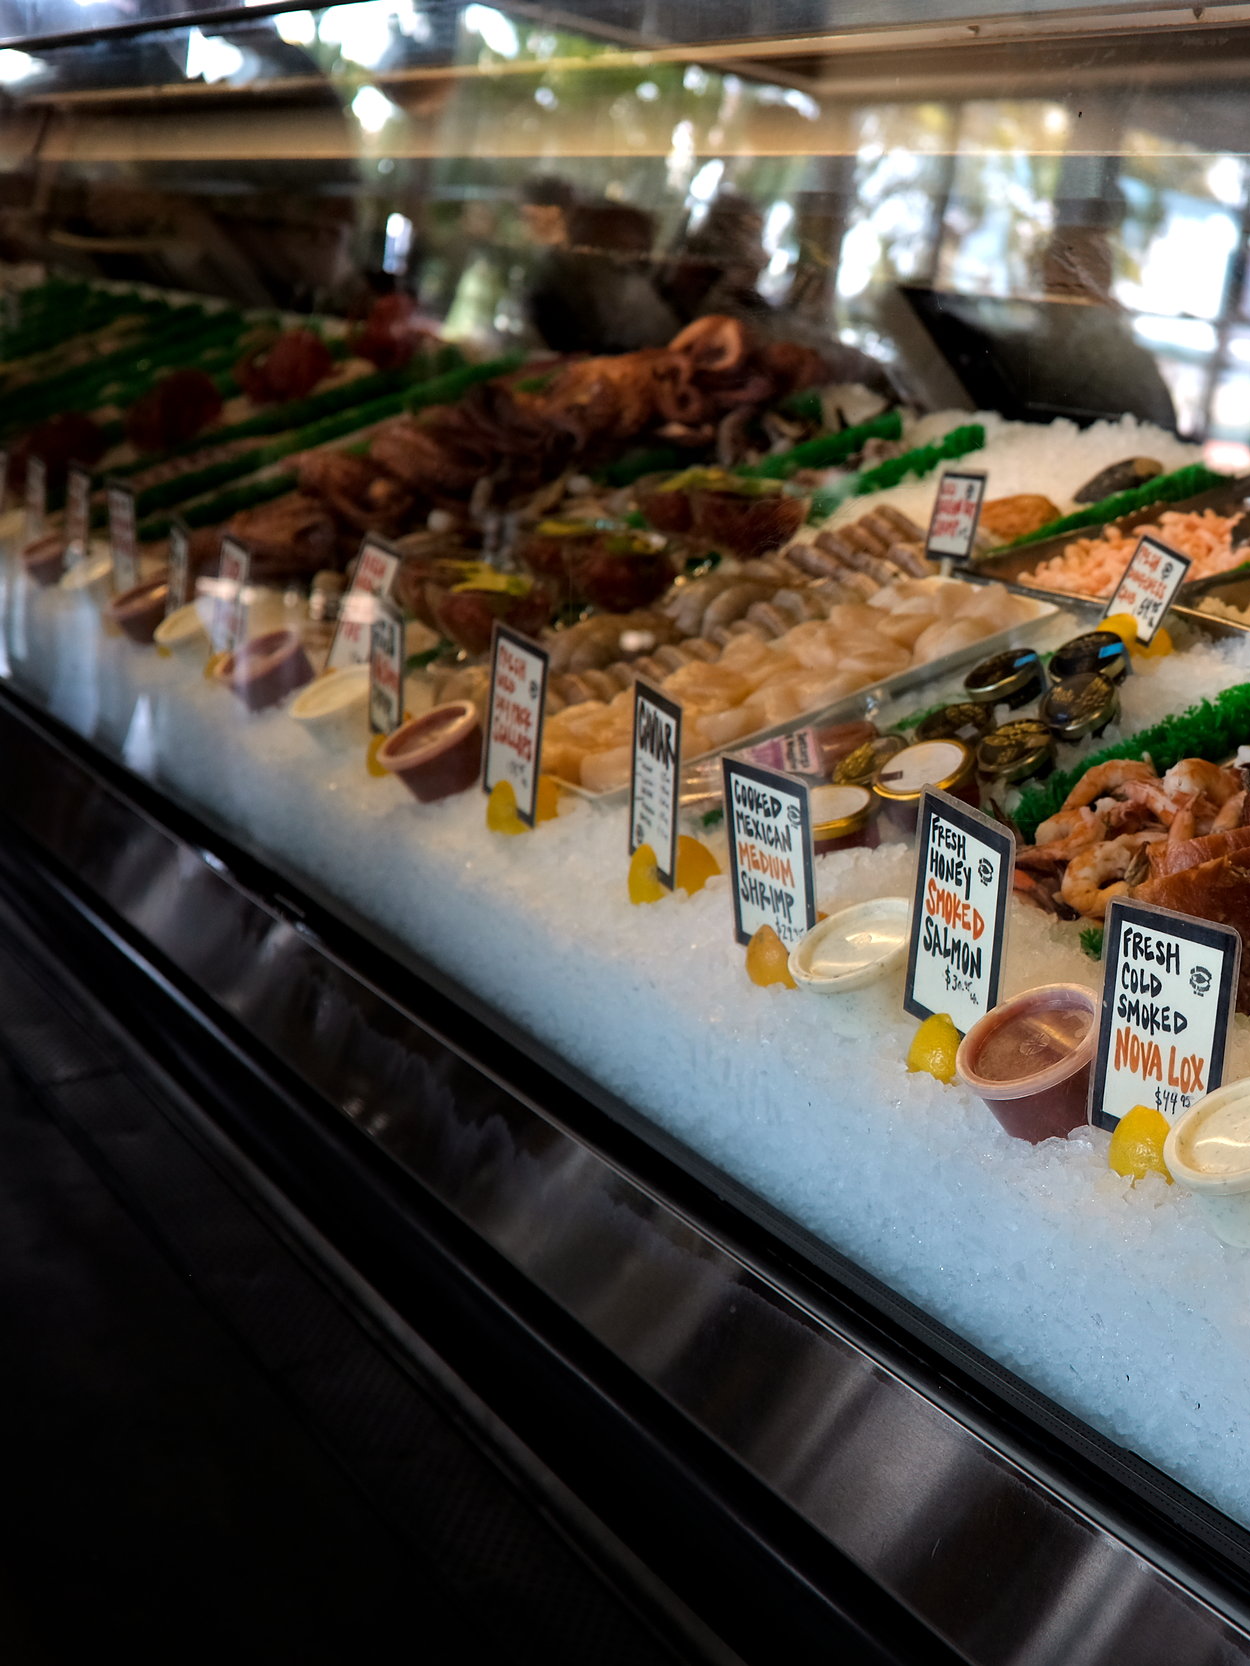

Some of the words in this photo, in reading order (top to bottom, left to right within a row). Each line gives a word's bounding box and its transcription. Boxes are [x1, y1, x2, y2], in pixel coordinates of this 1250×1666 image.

[638, 699, 676, 770] CAVIAR
[733, 779, 782, 819] COOKED
[735, 809, 792, 852] MEXICAN
[931, 817, 966, 860] FRESH
[738, 841, 795, 889] MEDIUM
[929, 847, 971, 900] HONEY
[740, 870, 795, 924] SHRIMP
[925, 877, 985, 940] SMOKED
[923, 916, 982, 979] SALMON
[1123, 927, 1181, 975] FRESH
[1121, 961, 1162, 998] COLD
[1117, 993, 1188, 1036] SMOKED
[1114, 1026, 1163, 1081] NOVA
[1167, 1044, 1205, 1094] LOX
